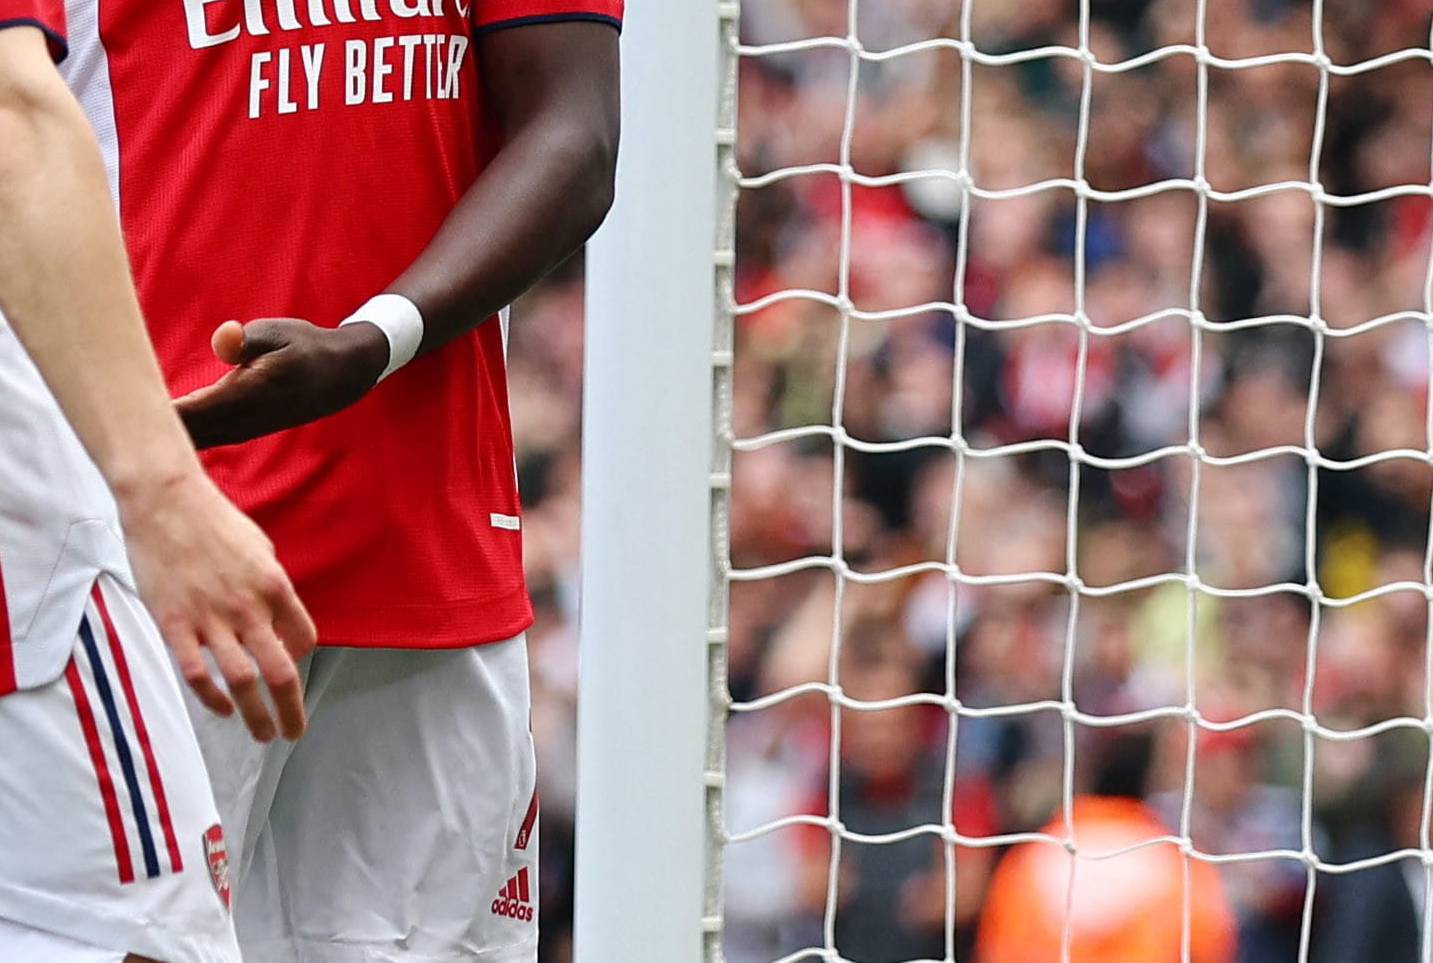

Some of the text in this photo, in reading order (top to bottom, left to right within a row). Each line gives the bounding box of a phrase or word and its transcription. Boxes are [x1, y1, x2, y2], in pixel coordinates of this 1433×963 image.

[249, 34, 468, 118] FLY BETTER
[491, 896, 533, 922] adidas
